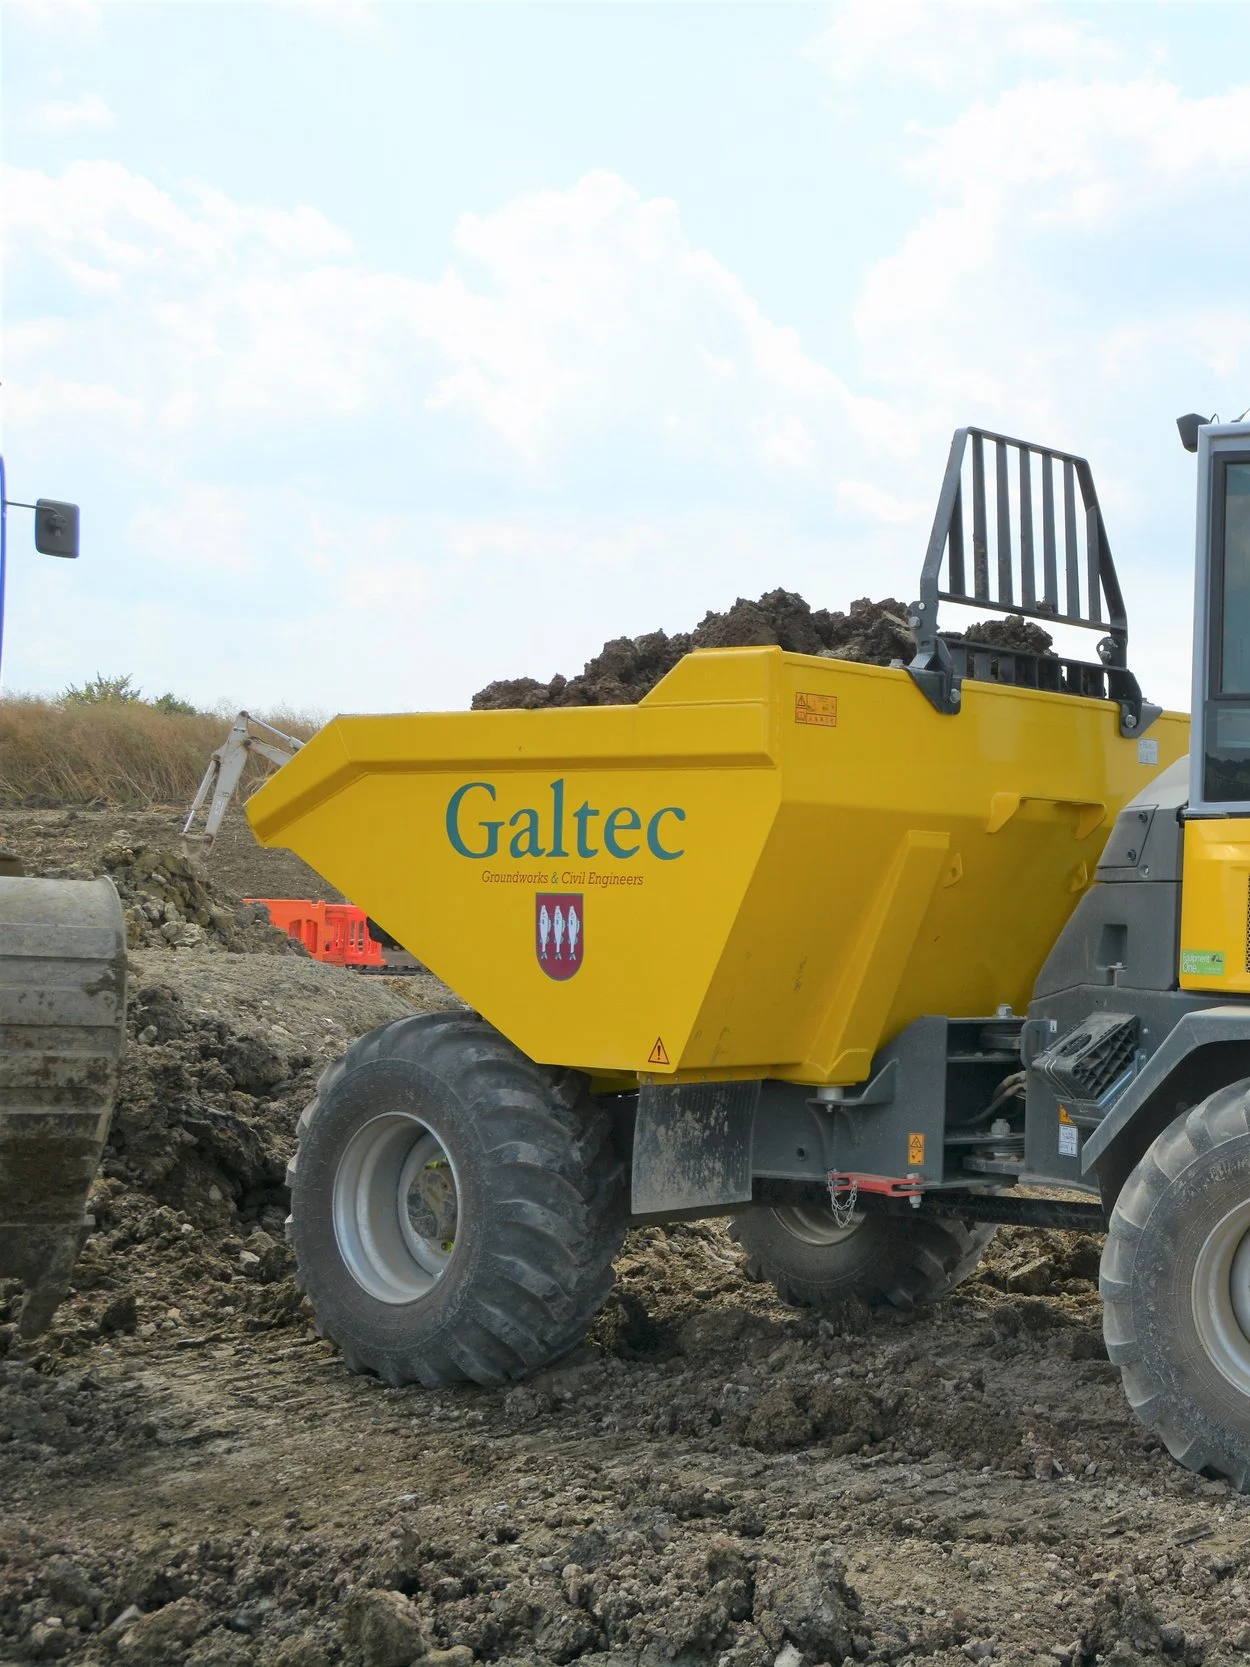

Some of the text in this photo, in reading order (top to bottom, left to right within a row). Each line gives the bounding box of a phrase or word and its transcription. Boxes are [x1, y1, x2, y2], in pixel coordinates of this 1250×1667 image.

[446, 778, 686, 860] Galtec
[481, 870, 644, 888] Groundworks & Civil Engineers
